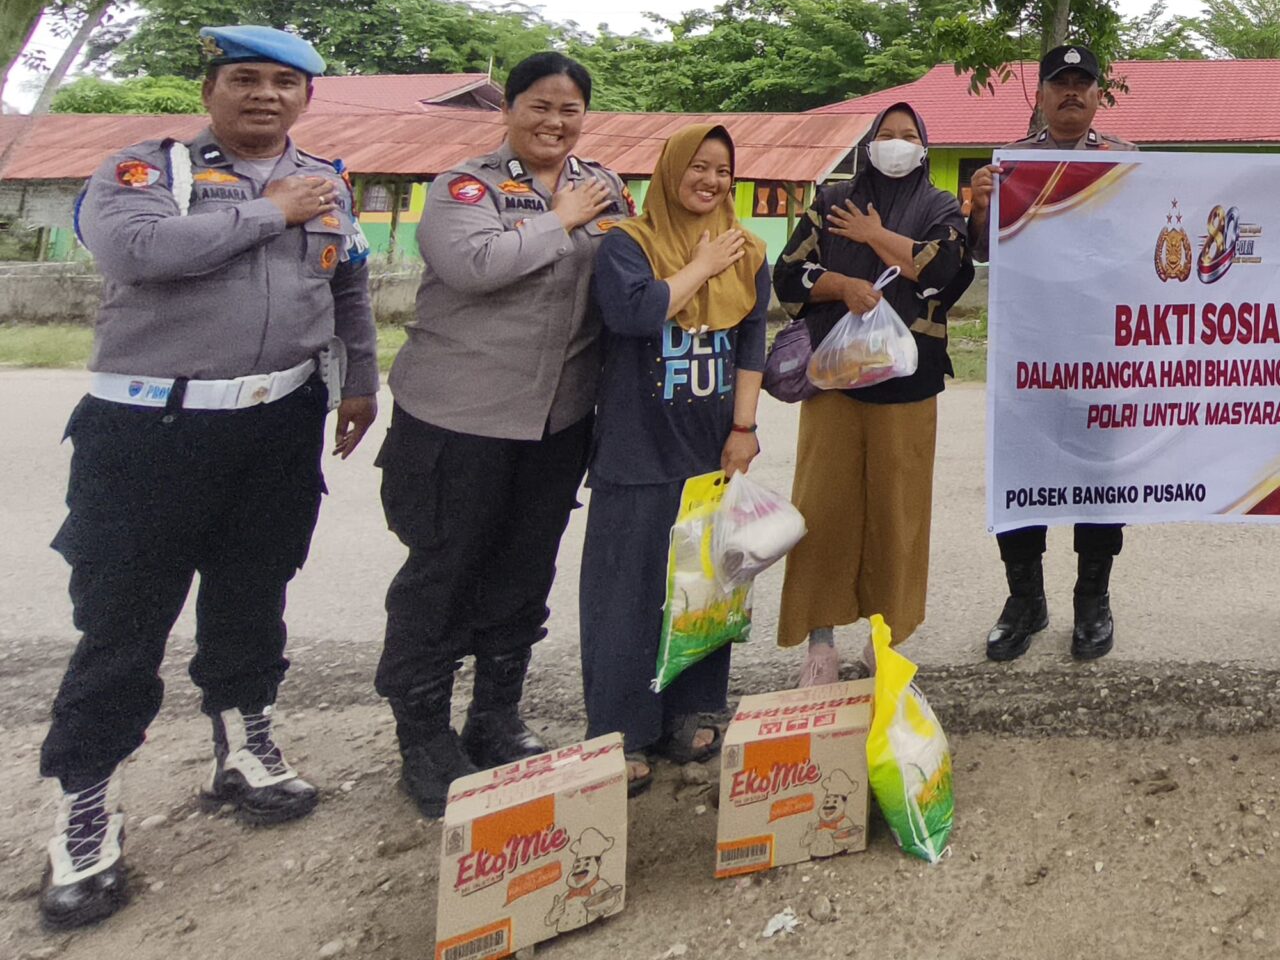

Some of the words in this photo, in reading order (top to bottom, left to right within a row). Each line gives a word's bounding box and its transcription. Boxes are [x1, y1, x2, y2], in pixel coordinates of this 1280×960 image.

[505, 196, 544, 212] MARIA
[1114, 304, 1196, 346] BAKTI
[663, 358, 732, 400] FUL
[1016, 361, 1079, 389] DALAM
[1082, 360, 1158, 389] RANGKA
[1160, 359, 1202, 387] HARI
[1086, 402, 1138, 429] POLRI
[1143, 401, 1201, 427] UNTUK
[1006, 486, 1068, 509] POLSEK
[1072, 485, 1139, 505] BANGKO
[1143, 482, 1207, 503] PUSAKO
